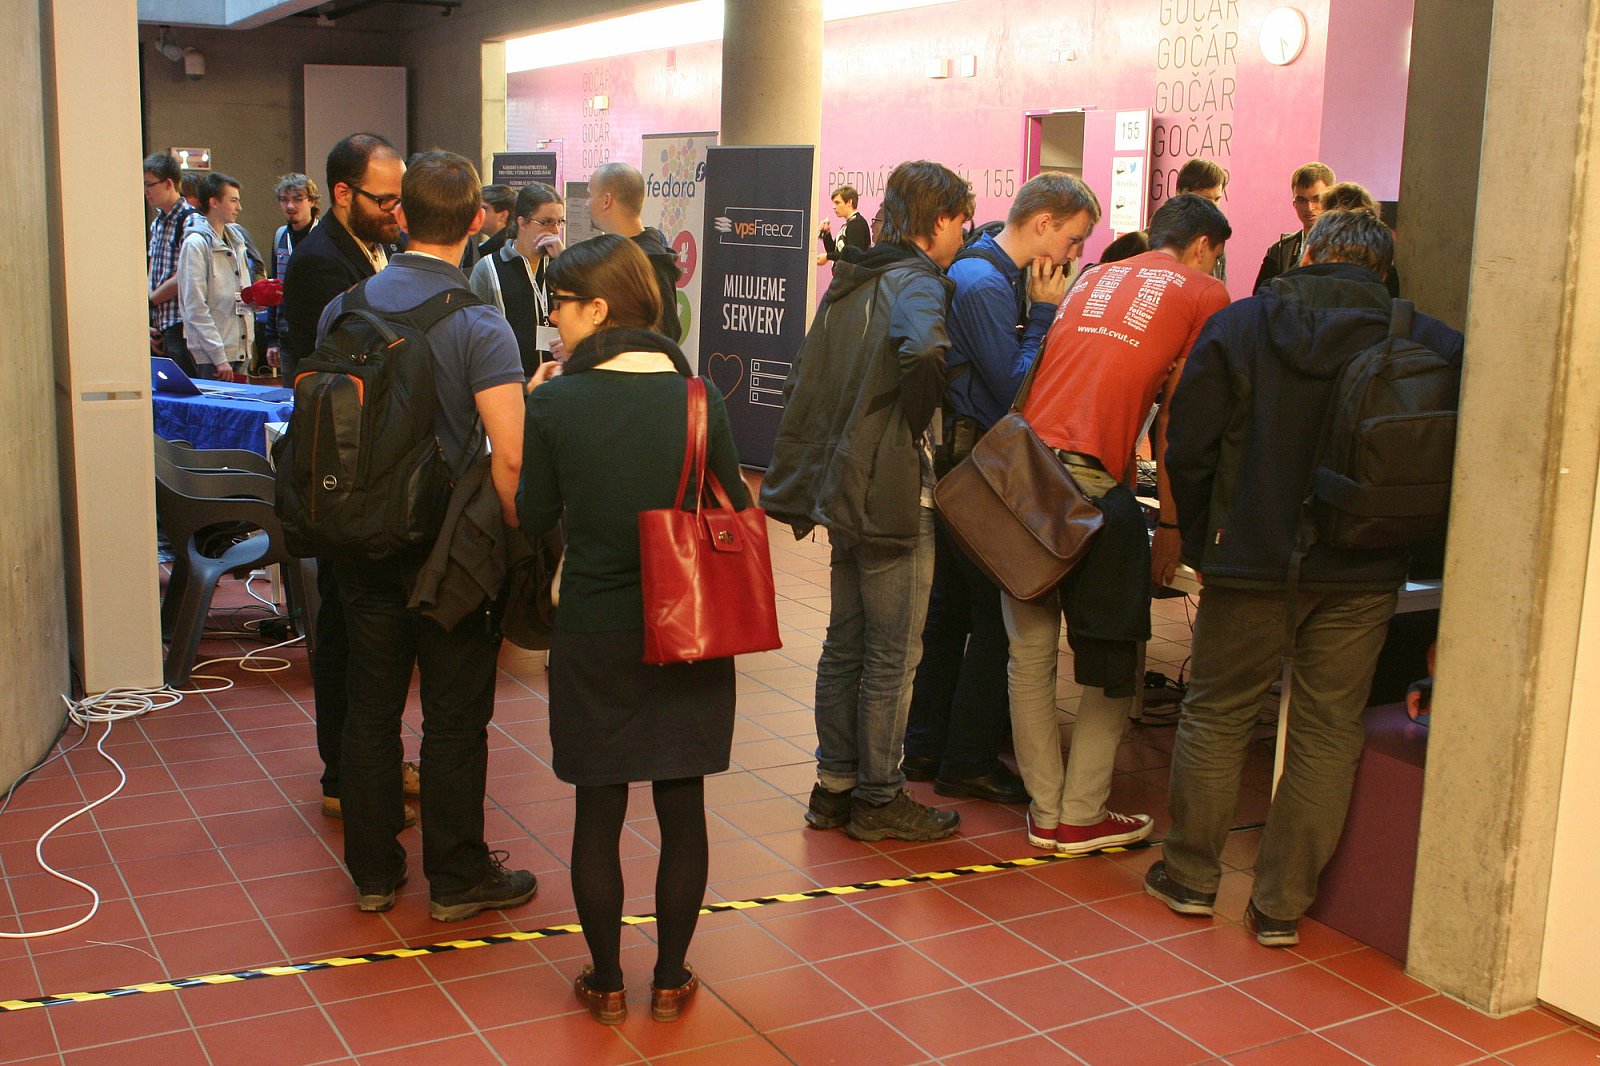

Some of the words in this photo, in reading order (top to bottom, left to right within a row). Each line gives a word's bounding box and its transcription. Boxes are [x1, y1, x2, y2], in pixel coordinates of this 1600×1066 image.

[1157, 23, 1239, 70] GOČÁR
[1155, 69, 1236, 114] GOČÁR
[582, 118, 610, 143] GOČÁR
[1121, 121, 1140, 140] 155
[1153, 114, 1233, 158] GOČÁR
[582, 144, 610, 168] GOČÁR
[646, 172, 695, 199] fedora
[984, 169, 1015, 198] 155
[734, 219, 794, 239] vpsFree.cz
[723, 274, 787, 302] MILUJEME
[1098, 279, 1120, 287] train
[1140, 287, 1164, 297] please
[1090, 292, 1112, 301] web
[1138, 291, 1161, 305] visit
[722, 302, 785, 336] SERVERY
[1129, 306, 1153, 320] follow
[1077, 325, 1140, 348] www.fit.cvut.cz
